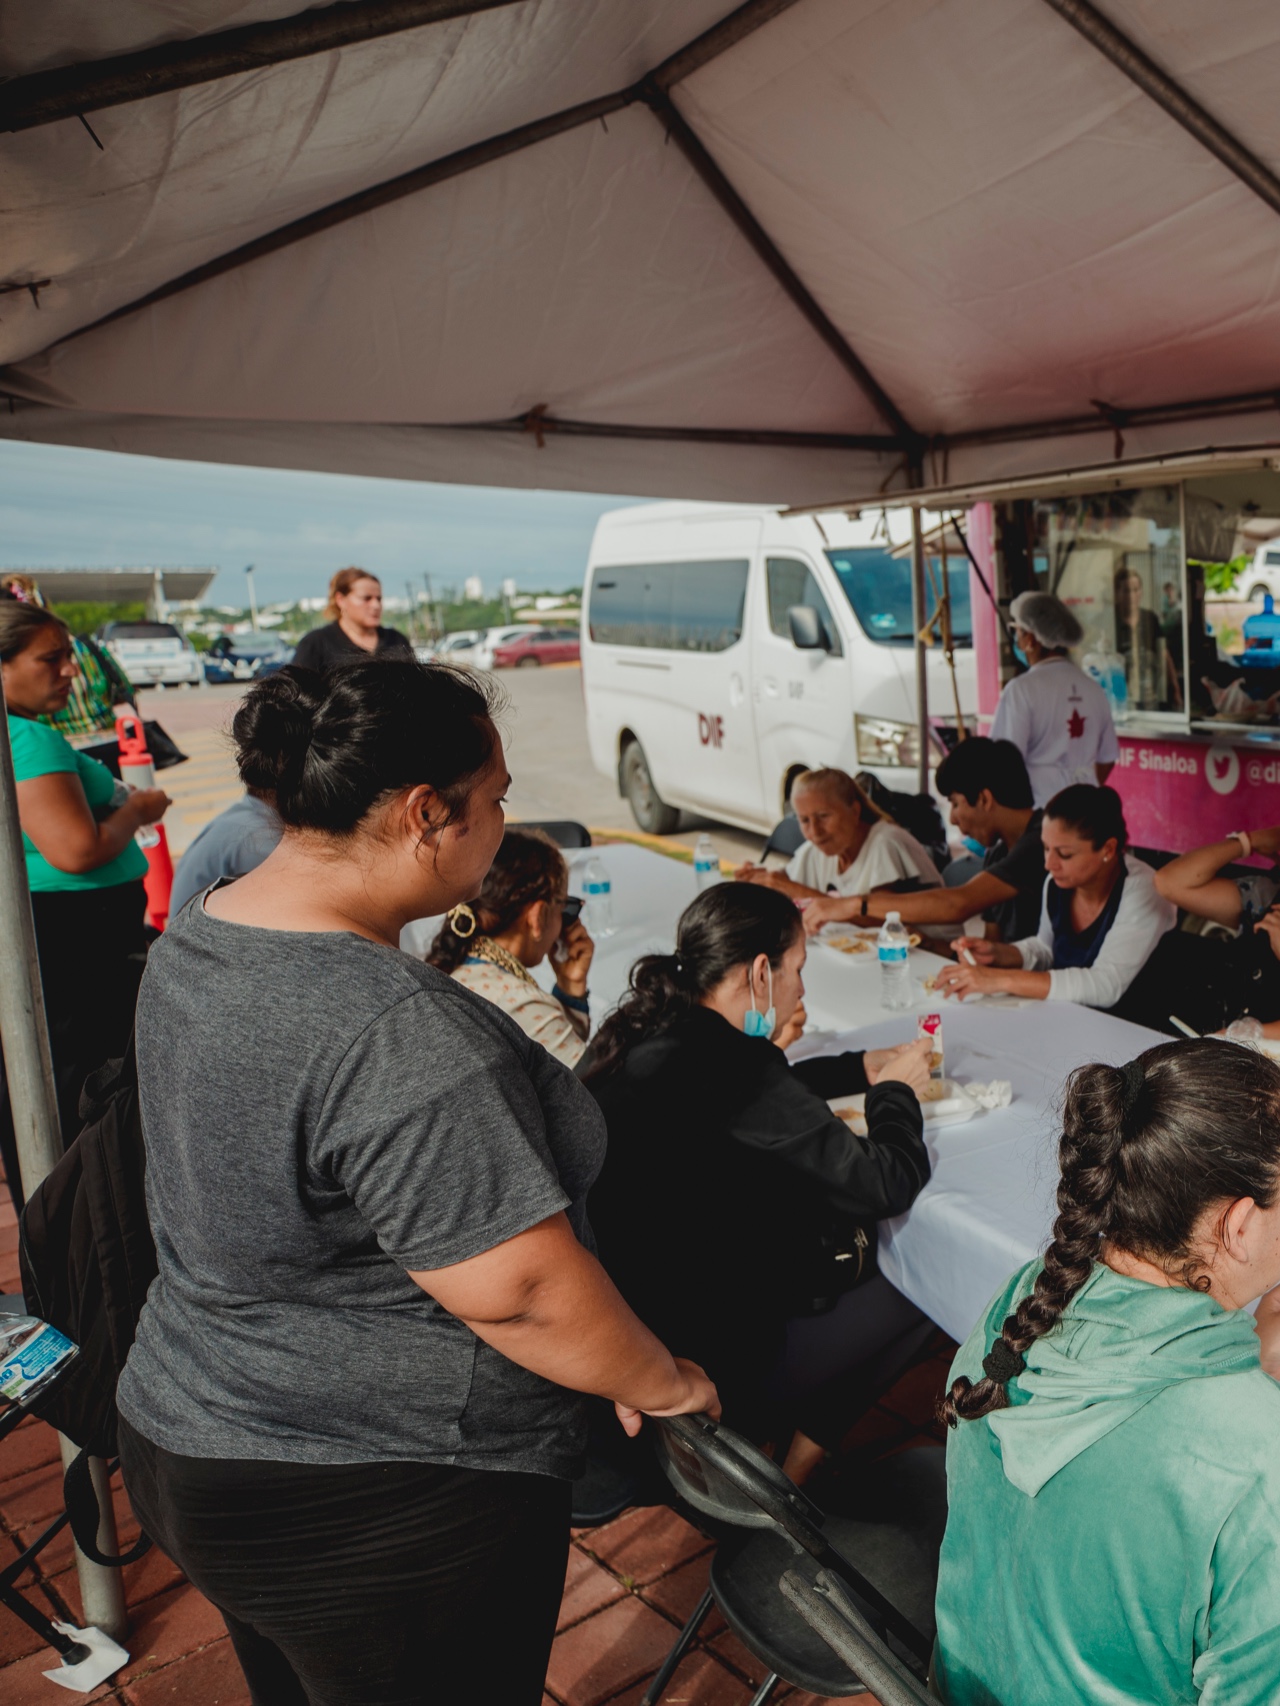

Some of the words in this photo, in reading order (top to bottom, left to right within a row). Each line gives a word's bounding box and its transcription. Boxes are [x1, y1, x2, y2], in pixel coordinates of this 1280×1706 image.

[698, 712, 725, 749] DIF
[1115, 748, 1136, 768] IF
[1138, 749, 1198, 775] Sinaloa
